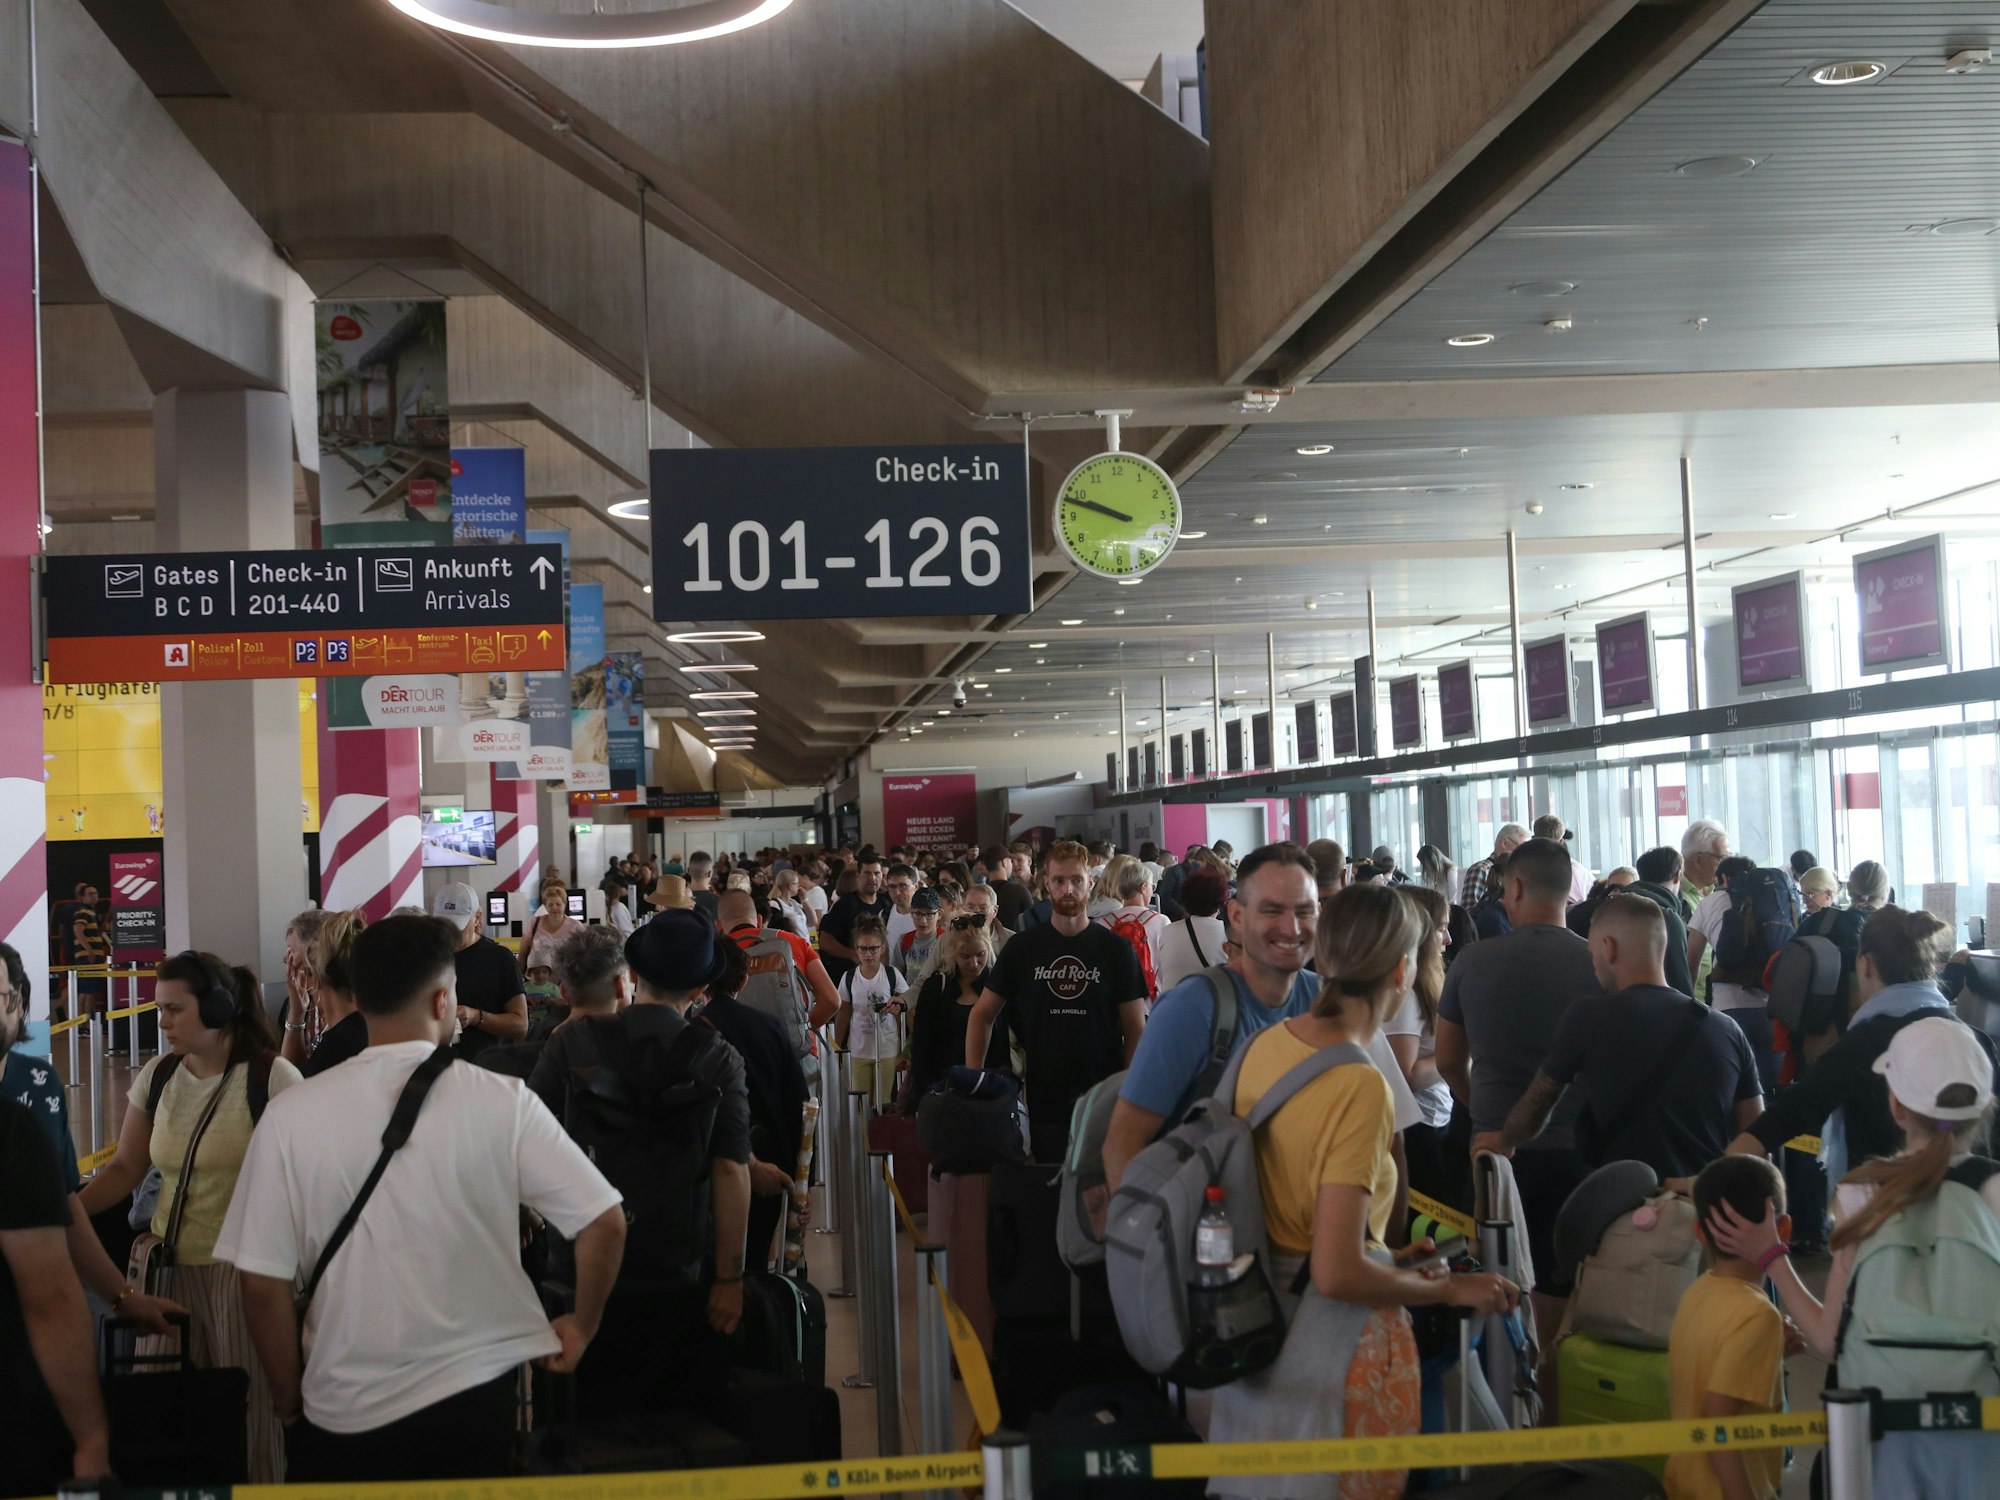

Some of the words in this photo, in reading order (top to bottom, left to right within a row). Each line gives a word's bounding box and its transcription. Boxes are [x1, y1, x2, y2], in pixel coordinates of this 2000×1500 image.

[875, 456, 1000, 482] Check-in
[1112, 466, 1123, 476] 12
[1090, 474, 1101, 484] 11
[1136, 473, 1142, 482] 1
[1074, 490, 1086, 500] 10
[1152, 490, 1158, 499] 2
[1070, 512, 1076, 521] 9
[1160, 510, 1166, 520] 3
[454, 526, 504, 538] Stätten
[1078, 533, 1084, 542] 8
[682, 516, 1002, 592] 101-126
[1094, 550, 1100, 560] 7
[1139, 550, 1146, 560] 5
[1116, 556, 1123, 566] 6
[248, 562, 348, 584] Check-in
[424, 557, 513, 580] Ankunft
[154, 565, 219, 586] Gates
[248, 592, 340, 616] 201-440
[426, 588, 510, 610] Arrivals
[156, 598, 168, 617] B
[178, 596, 190, 616] C
[201, 596, 214, 616] D
[417, 633, 459, 642] Konferenz-
[472, 636, 493, 646] Taxi
[198, 642, 235, 654] Polizei
[244, 642, 264, 653] Zoll
[198, 655, 230, 666] Police
[244, 654, 286, 666] Customs
[381, 686, 444, 702] DERTOUR
[1848, 691, 1862, 710] 115
[381, 706, 410, 714] MACHT
[412, 704, 445, 714] URLAUB
[1726, 708, 1738, 727] 114
[473, 730, 520, 743] DERTOUR
[889, 783, 923, 791] Eurowings
[117, 911, 156, 920] PRIORITY-
[1034, 965, 1067, 980] Hard
[1068, 965, 1101, 983] Rock
[1734, 1426, 1764, 1440] Köln
[1770, 1424, 1804, 1438] Bonn
[846, 1470, 879, 1484] Köln
[885, 1468, 920, 1483] Bonn
[926, 1464, 981, 1481] Airport
